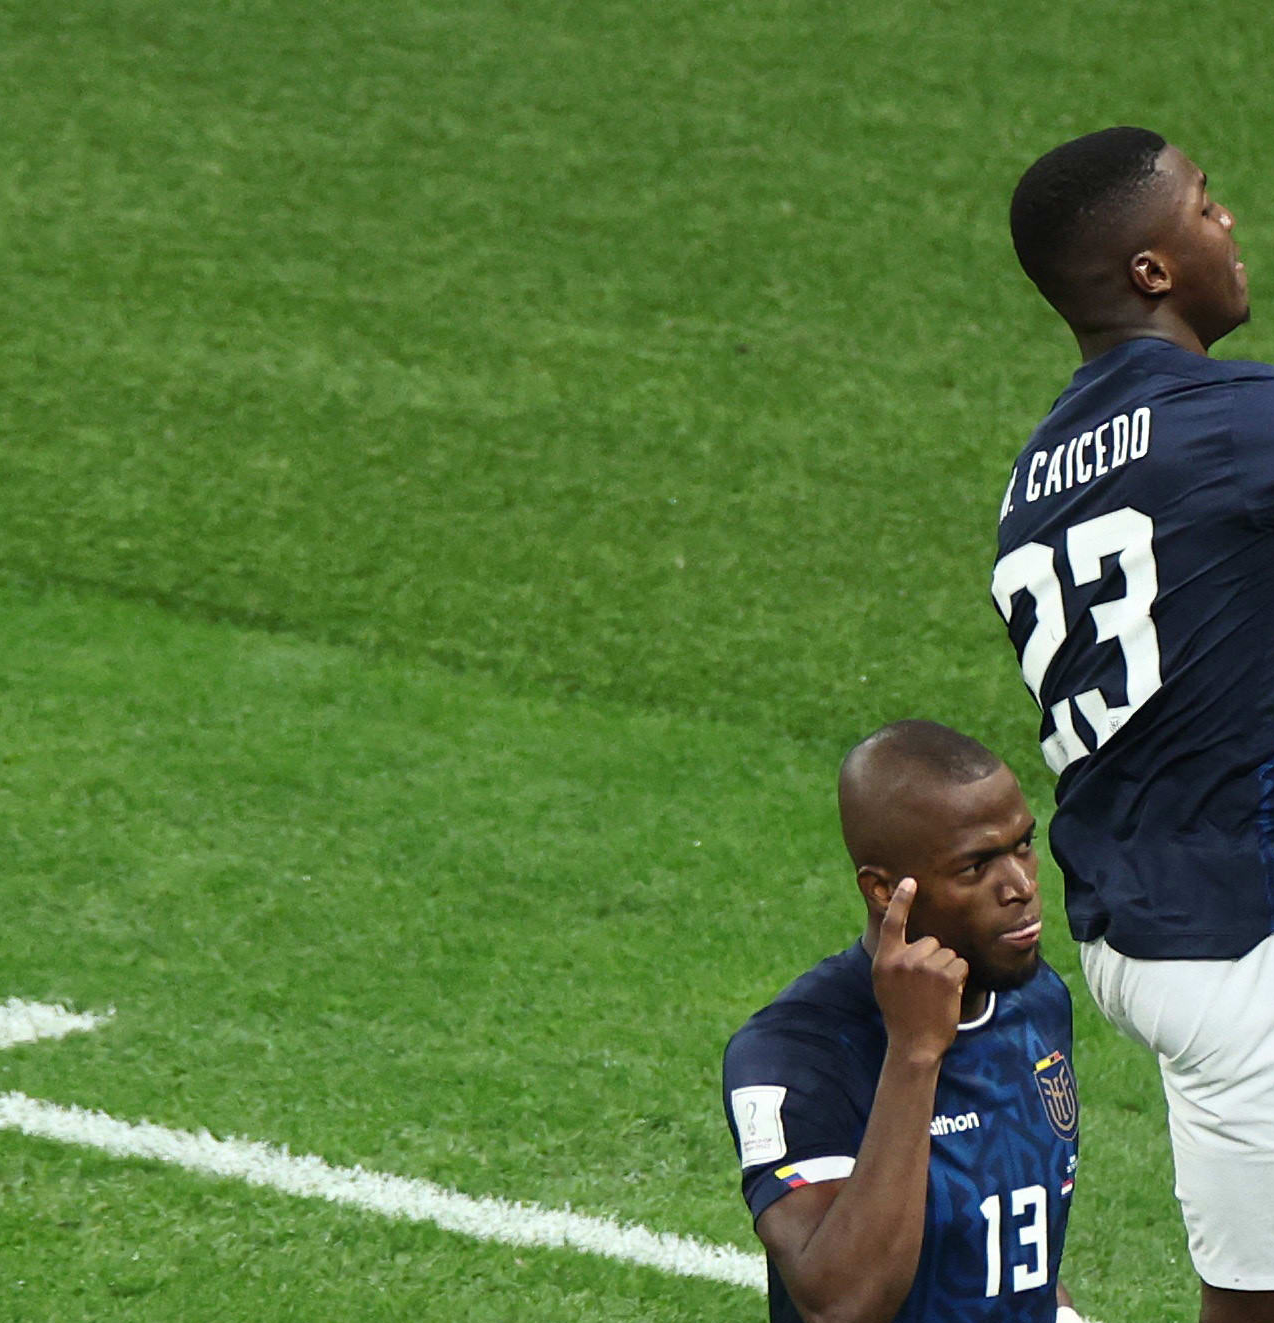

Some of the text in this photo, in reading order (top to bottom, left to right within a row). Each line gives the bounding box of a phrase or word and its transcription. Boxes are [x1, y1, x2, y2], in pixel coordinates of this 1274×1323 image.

[1025, 406, 1151, 503] CAICEDO
[991, 506, 1164, 777] 23
[930, 1111, 980, 1136] athon
[980, 1185, 1048, 1298] 13
